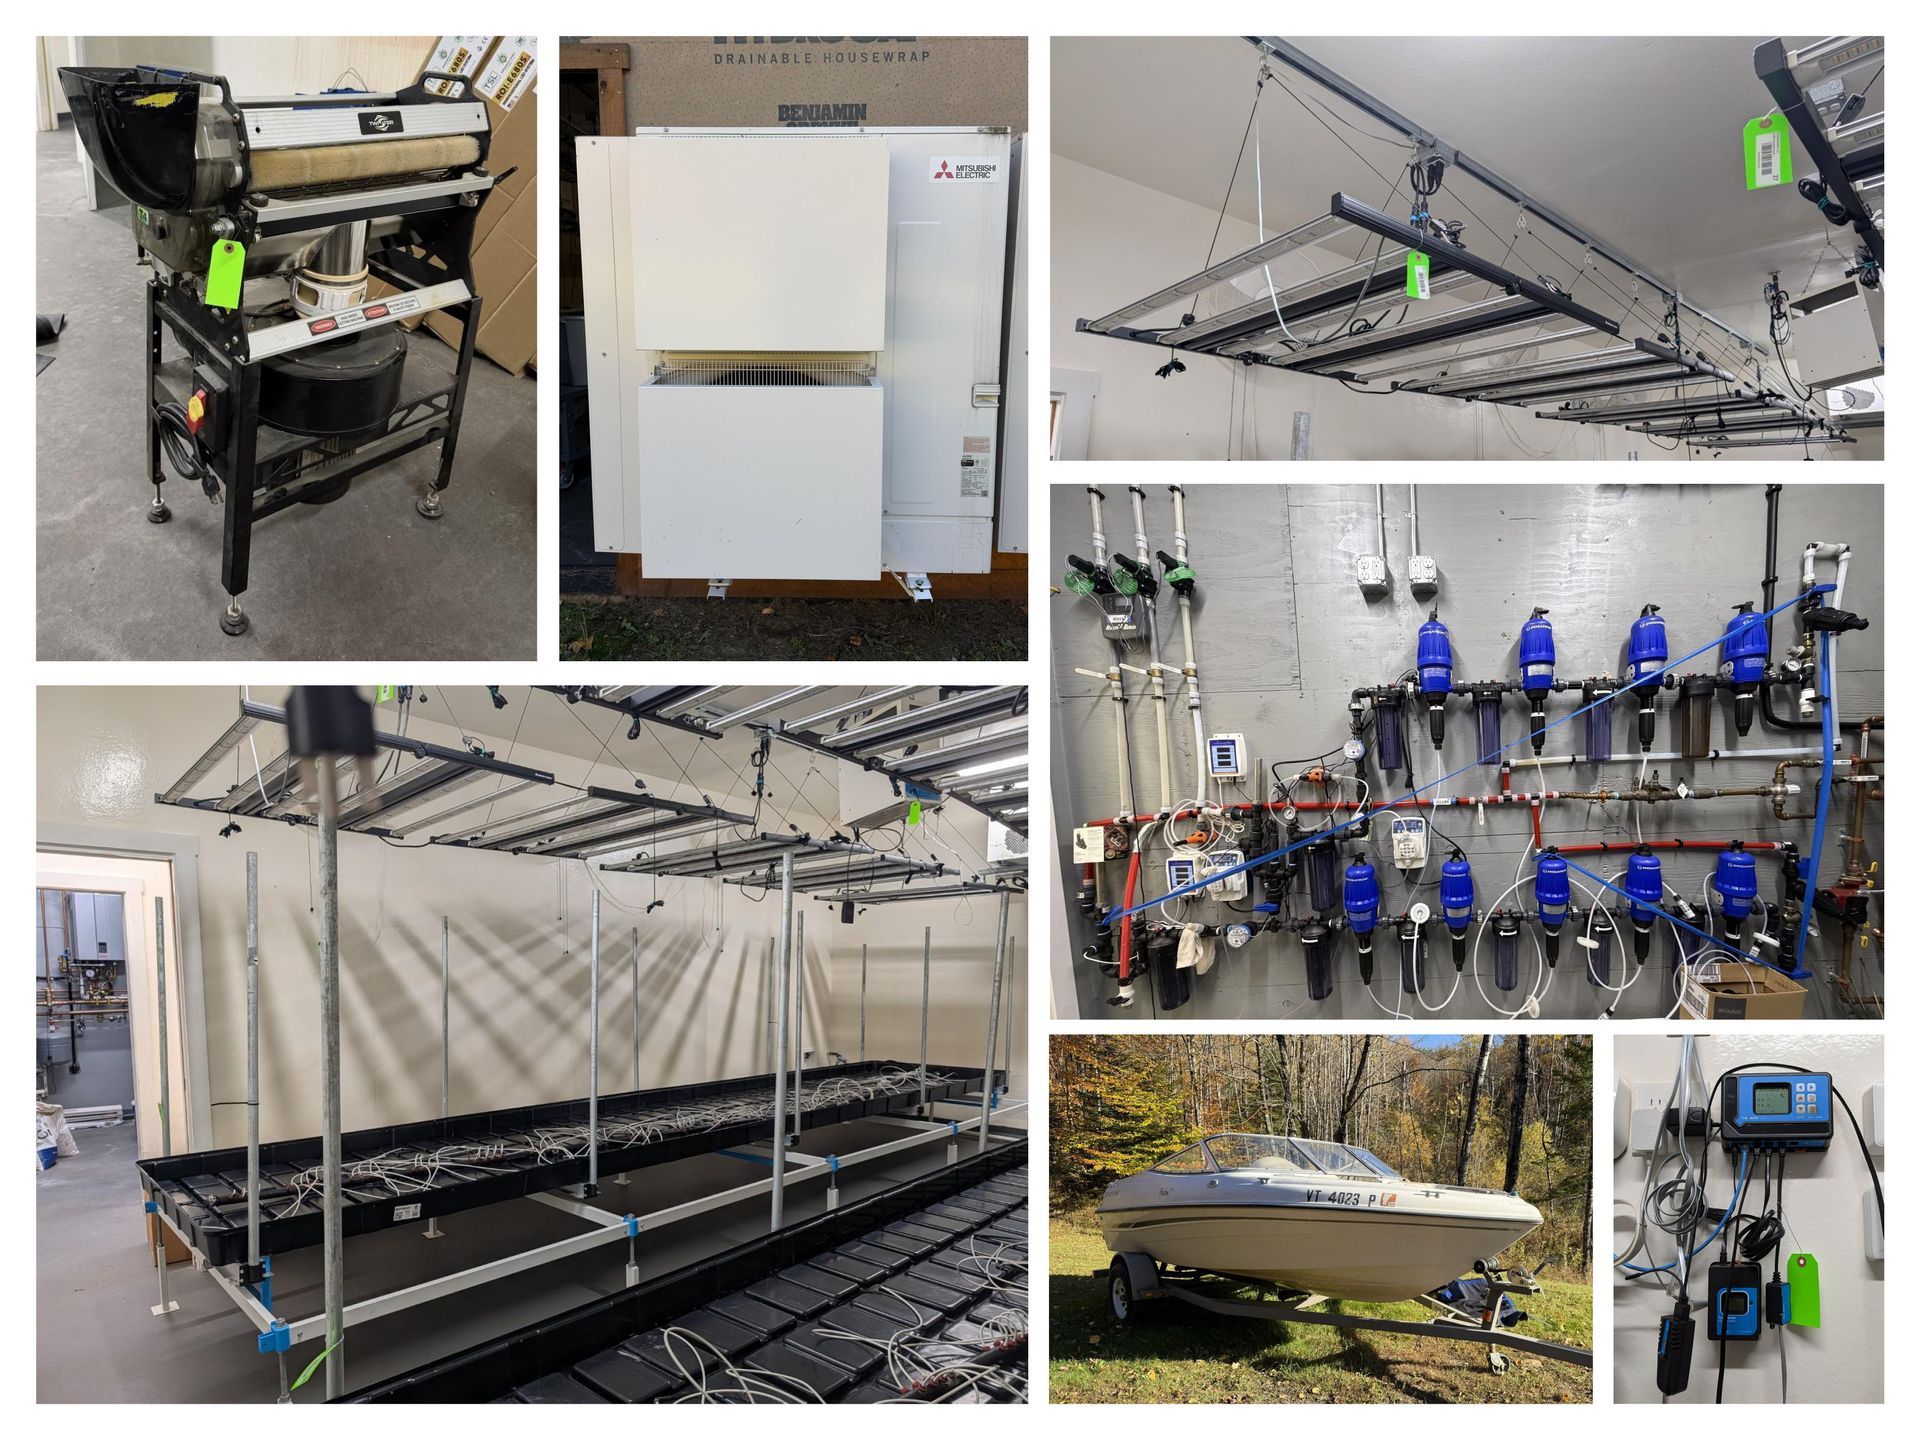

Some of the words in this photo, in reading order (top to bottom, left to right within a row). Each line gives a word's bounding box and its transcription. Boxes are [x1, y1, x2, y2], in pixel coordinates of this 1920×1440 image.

[714, 52, 813, 64] DRAINABLE
[823, 51, 931, 63] HOUSEWRAP
[495, 56, 527, 101] ROI-E680S
[778, 103, 867, 121] BENJAMIN
[955, 164, 996, 172] MITSUBISHI
[138, 207, 147, 221] T4
[1306, 1189, 1321, 1202] VT
[1328, 1191, 1360, 1206] 4023
[1367, 1194, 1376, 1207] P
